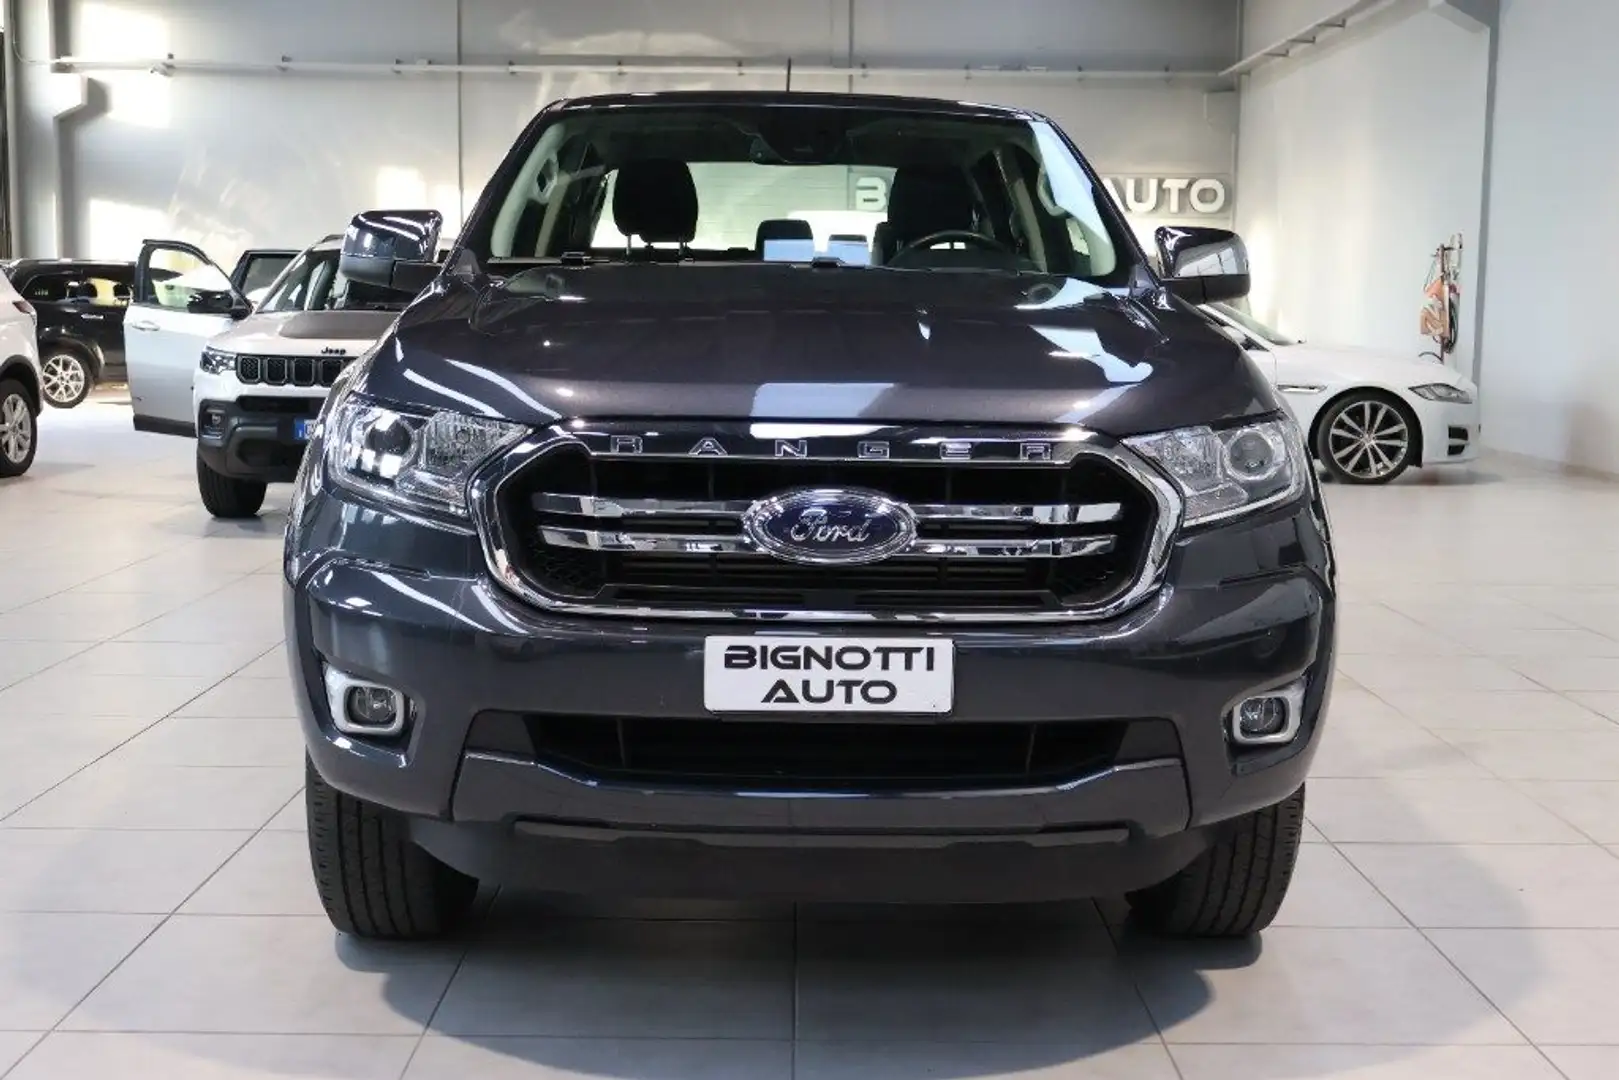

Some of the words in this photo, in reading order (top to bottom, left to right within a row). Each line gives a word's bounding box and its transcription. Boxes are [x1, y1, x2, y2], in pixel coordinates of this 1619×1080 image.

[609, 435, 1052, 461] RANGER
[790, 506, 873, 543] Ford
[723, 645, 935, 671] BIGNOTTI
[760, 678, 898, 704] AUTO
